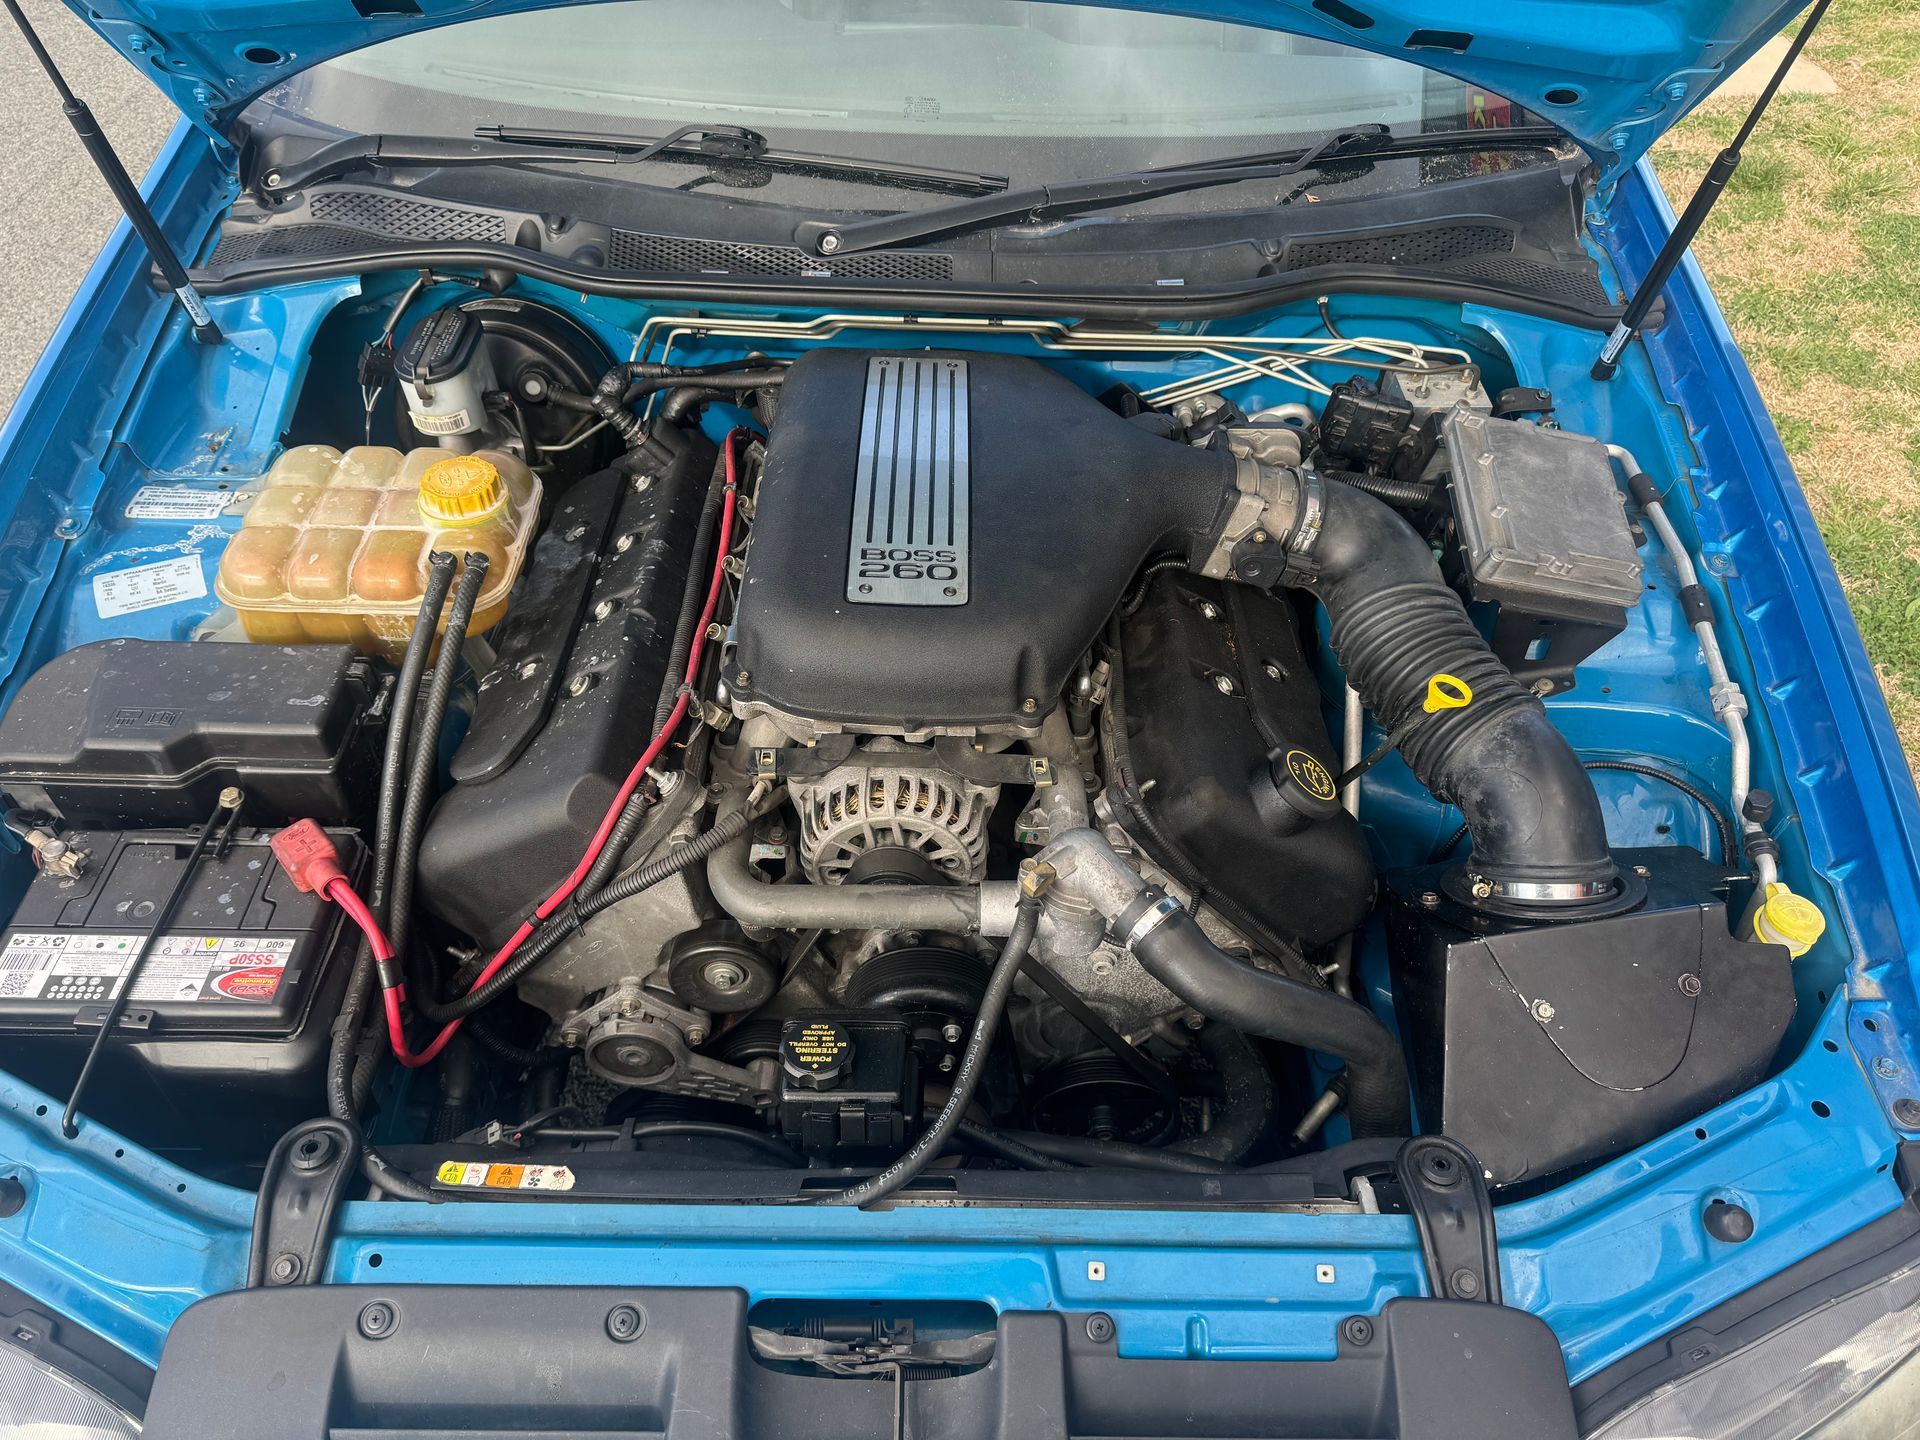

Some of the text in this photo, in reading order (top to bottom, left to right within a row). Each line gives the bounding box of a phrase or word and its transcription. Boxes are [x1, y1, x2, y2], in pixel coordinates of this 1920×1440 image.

[860, 547, 957, 563] BOSS
[859, 562, 958, 581] 260
[1292, 761, 1300, 776] OIL
[375, 854, 387, 887] MACKAY
[233, 940, 246, 948] 95
[266, 941, 285, 949] 600
[229, 953, 275, 965] SS50P
[960, 1044, 980, 1082] MACKAY
[878, 1161, 904, 1187] 4033
